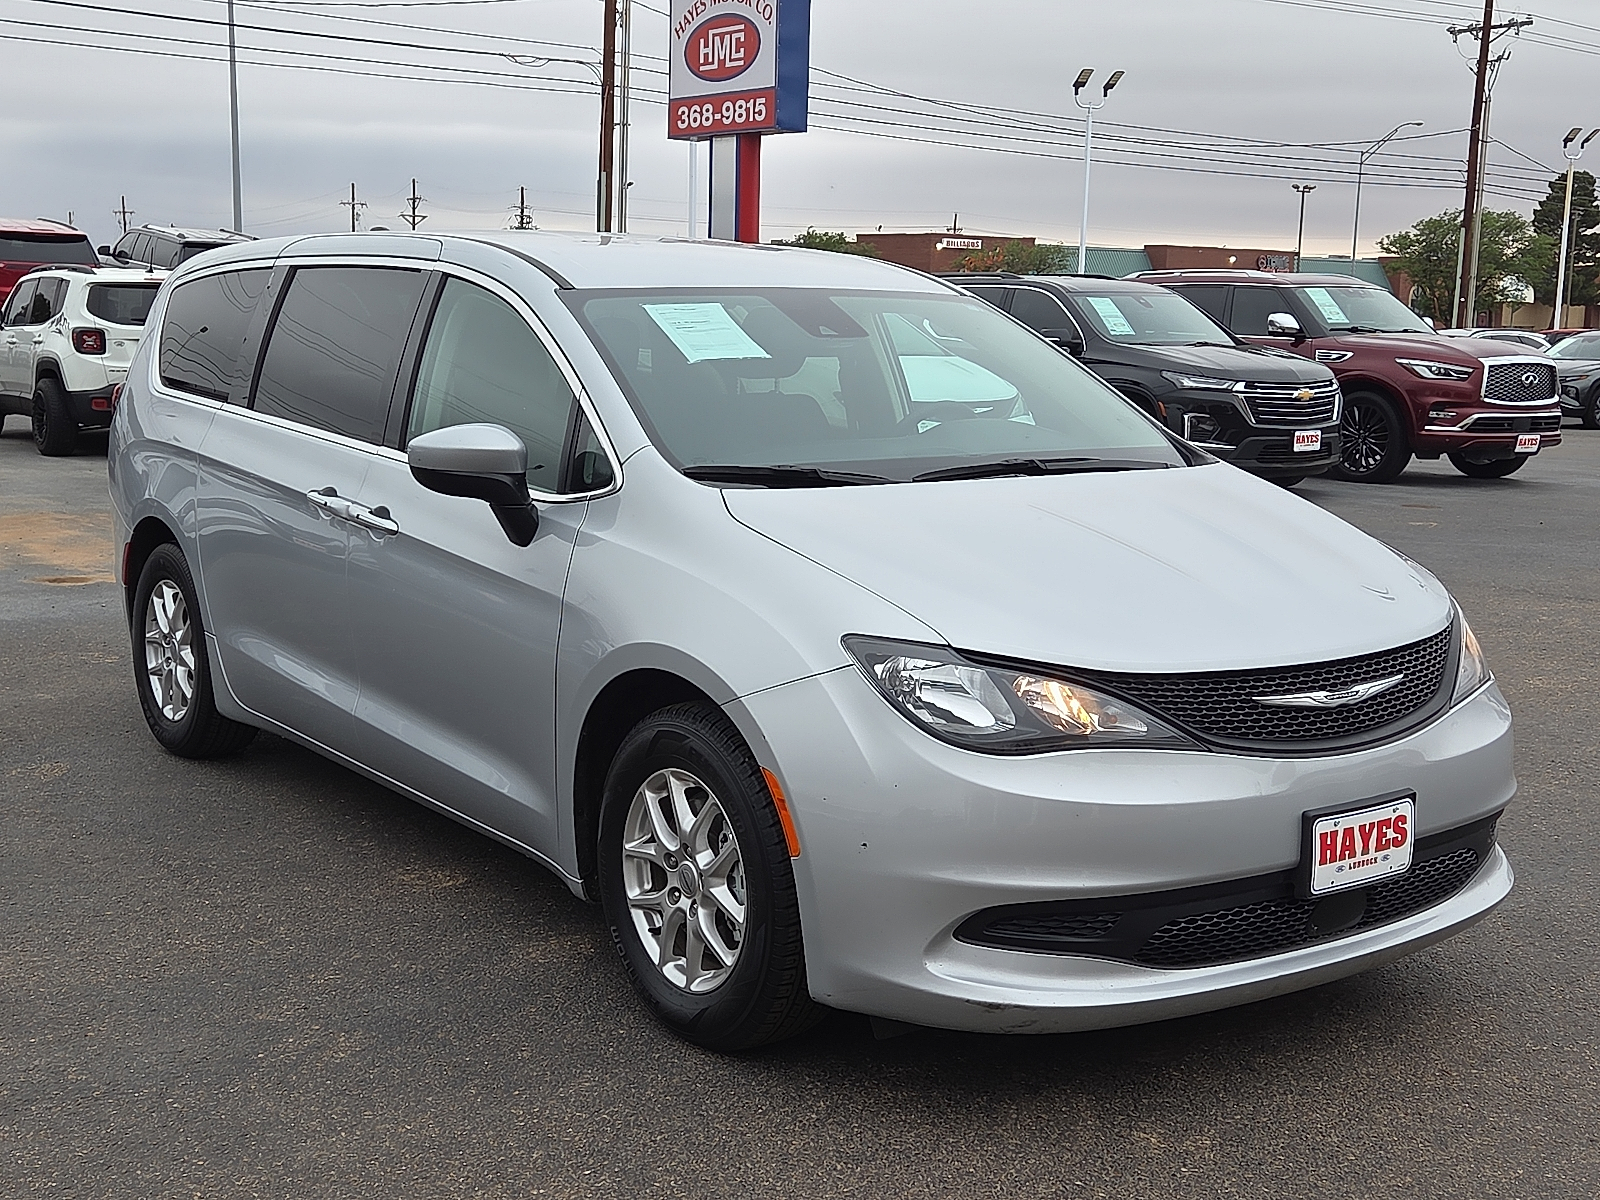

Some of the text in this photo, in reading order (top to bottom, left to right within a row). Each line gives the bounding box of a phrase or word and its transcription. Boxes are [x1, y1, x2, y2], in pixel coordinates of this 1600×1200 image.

[674, 0, 707, 40] HAYES
[699, 23, 745, 71] HMC
[677, 97, 767, 129] 368-9815
[1296, 434, 1320, 444] HAYES
[1318, 814, 1408, 866] HAYES
